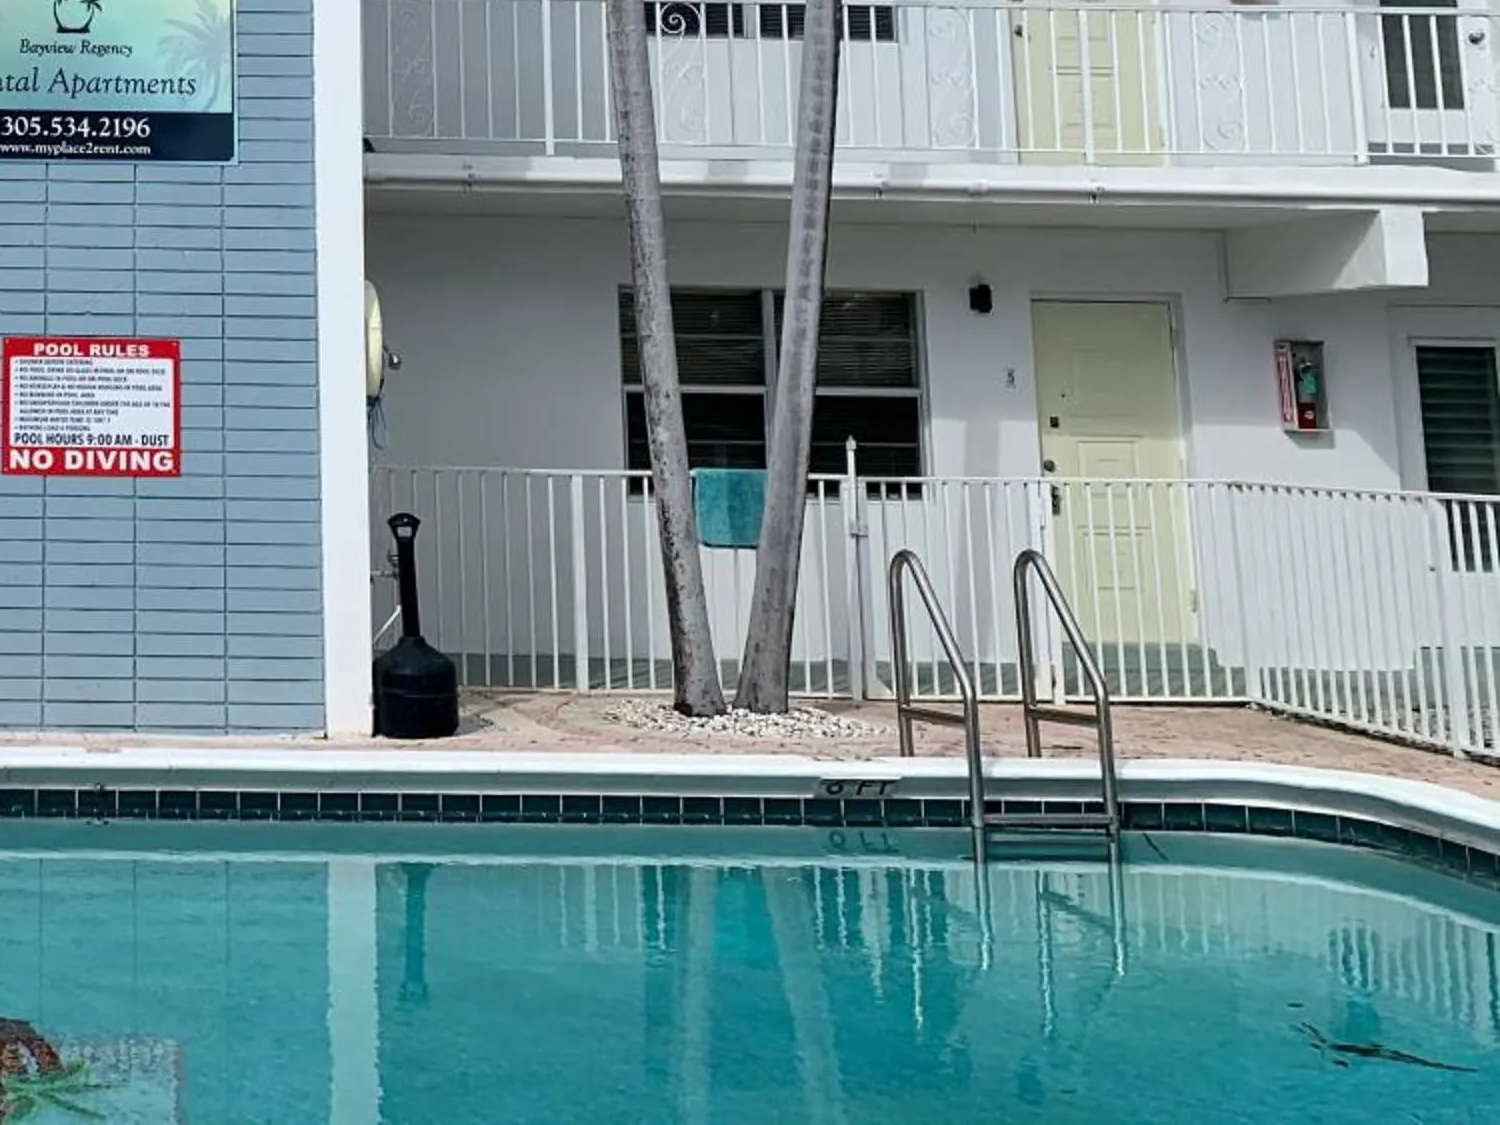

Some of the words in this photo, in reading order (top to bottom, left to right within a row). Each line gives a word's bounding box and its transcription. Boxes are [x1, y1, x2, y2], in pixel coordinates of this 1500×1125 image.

[19, 38, 77, 57] Bayview
[80, 39, 133, 58] Regency
[48, 67, 197, 99] Apartments
[0, 115, 151, 138] 305.534.2196
[0, 140, 151, 156] www.myplace2rent.com
[33, 342, 84, 356] POOL
[89, 343, 150, 357] RULES
[14, 432, 44, 445] POOL
[46, 432, 85, 446] HOURS
[87, 433, 113, 446] 9:00
[115, 434, 133, 446] AM
[141, 434, 169, 447] DUST
[9, 449, 54, 470] NO
[64, 450, 174, 471] DIVING
[856, 780, 898, 795] FT
